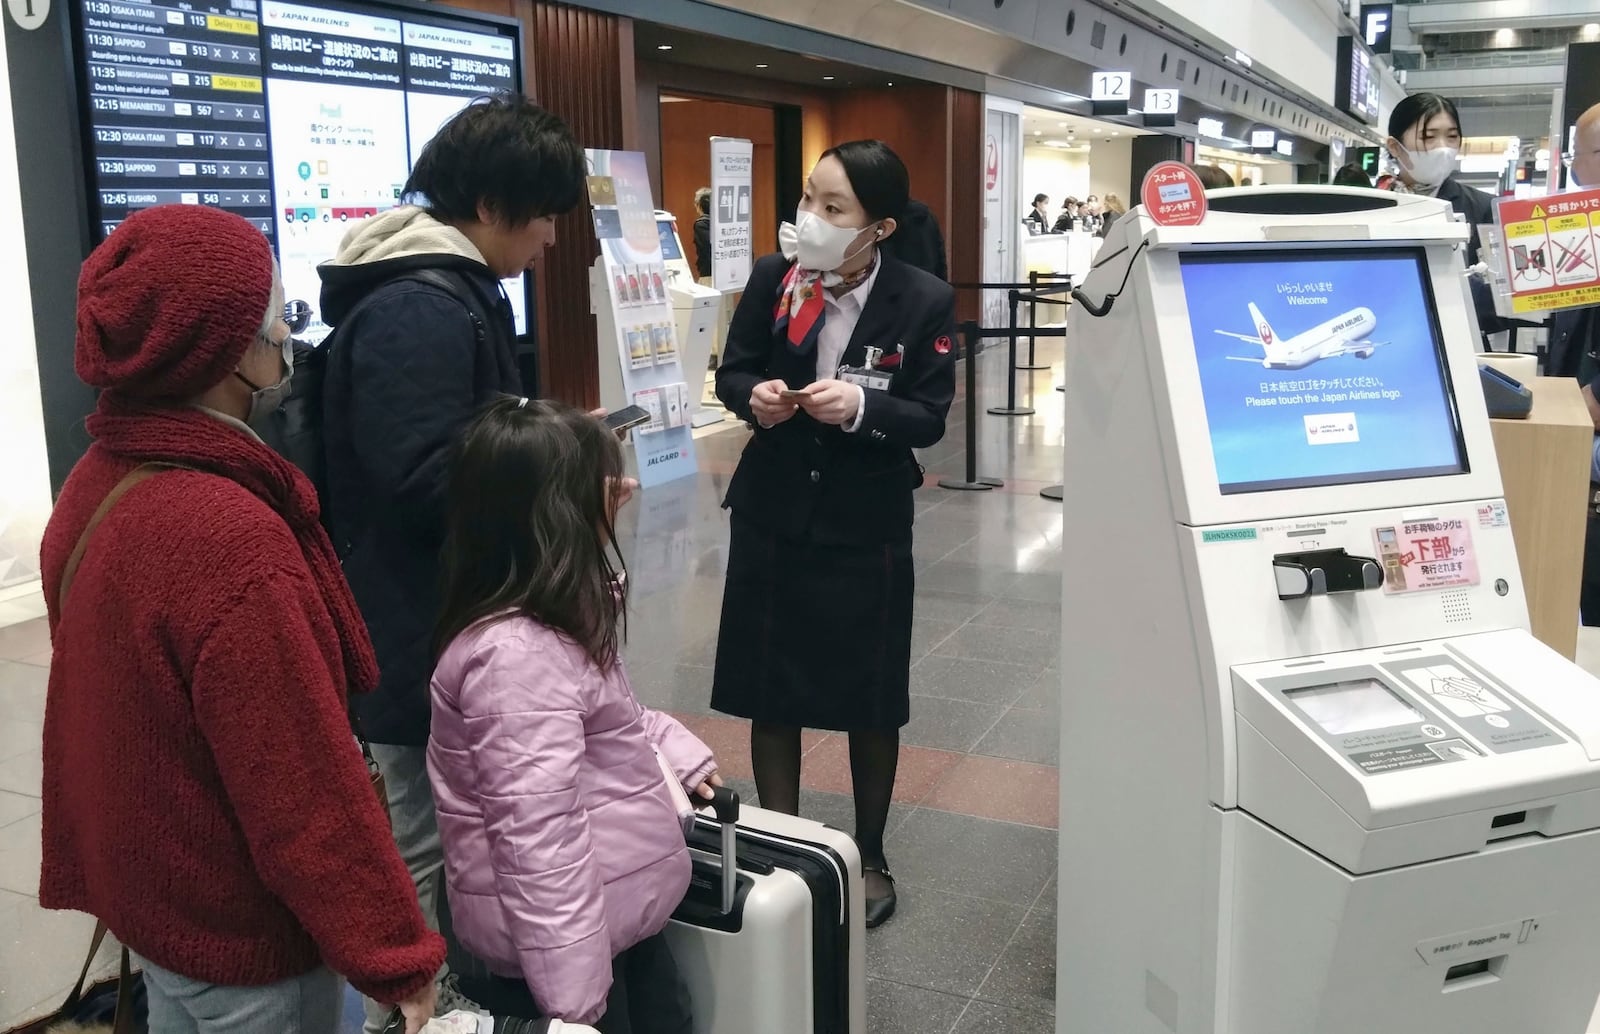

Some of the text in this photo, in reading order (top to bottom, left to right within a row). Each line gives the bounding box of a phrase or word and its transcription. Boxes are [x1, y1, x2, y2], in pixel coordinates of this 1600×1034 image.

[85, 1, 110, 14] 11:30
[112, 6, 155, 18] OSAKA ITAMI
[191, 16, 205, 26] 115
[282, 12, 350, 27] JAPAN AIRLINES
[1366, 13, 1388, 45] F
[88, 34, 113, 46] 11:30
[114, 38, 146, 48] SAPPORO
[418, 33, 472, 46] JAPAN AIRLINES
[192, 46, 208, 56] 513
[92, 66, 116, 78] 11:35
[194, 76, 210, 86] 215
[1099, 76, 1124, 96] 12
[94, 98, 118, 110] 12:15
[120, 102, 166, 112] MEMANBETSU
[1152, 92, 1172, 110] 13
[197, 106, 212, 116] 567
[98, 131, 122, 142] 12:30
[122, 133, 166, 142] OSAKA ITAMI
[200, 136, 214, 145] 117
[100, 162, 124, 173] 12:30
[1362, 153, 1374, 170] F
[125, 164, 156, 172] SAPPORO
[202, 164, 217, 174] 515
[102, 194, 127, 204] 12:45
[204, 194, 219, 204] 543
[1277, 281, 1333, 294] いらっしゃいませ
[1286, 295, 1328, 305] Welcome
[1332, 314, 1364, 334] JAPAN AIRLINES
[1260, 376, 1384, 394] 日本航空ロゴをタッチしてください。
[1245, 396, 1278, 407] Please
[1278, 394, 1302, 405] touch
[1304, 394, 1319, 404] the
[1321, 393, 1348, 404] Japan
[1349, 390, 1380, 401] Airlines
[648, 452, 679, 466] JALCARD
[1404, 520, 1462, 534] お手荷物のタグは
[1421, 562, 1463, 575] 発行されます
[1468, 936, 1497, 946] Baggage
